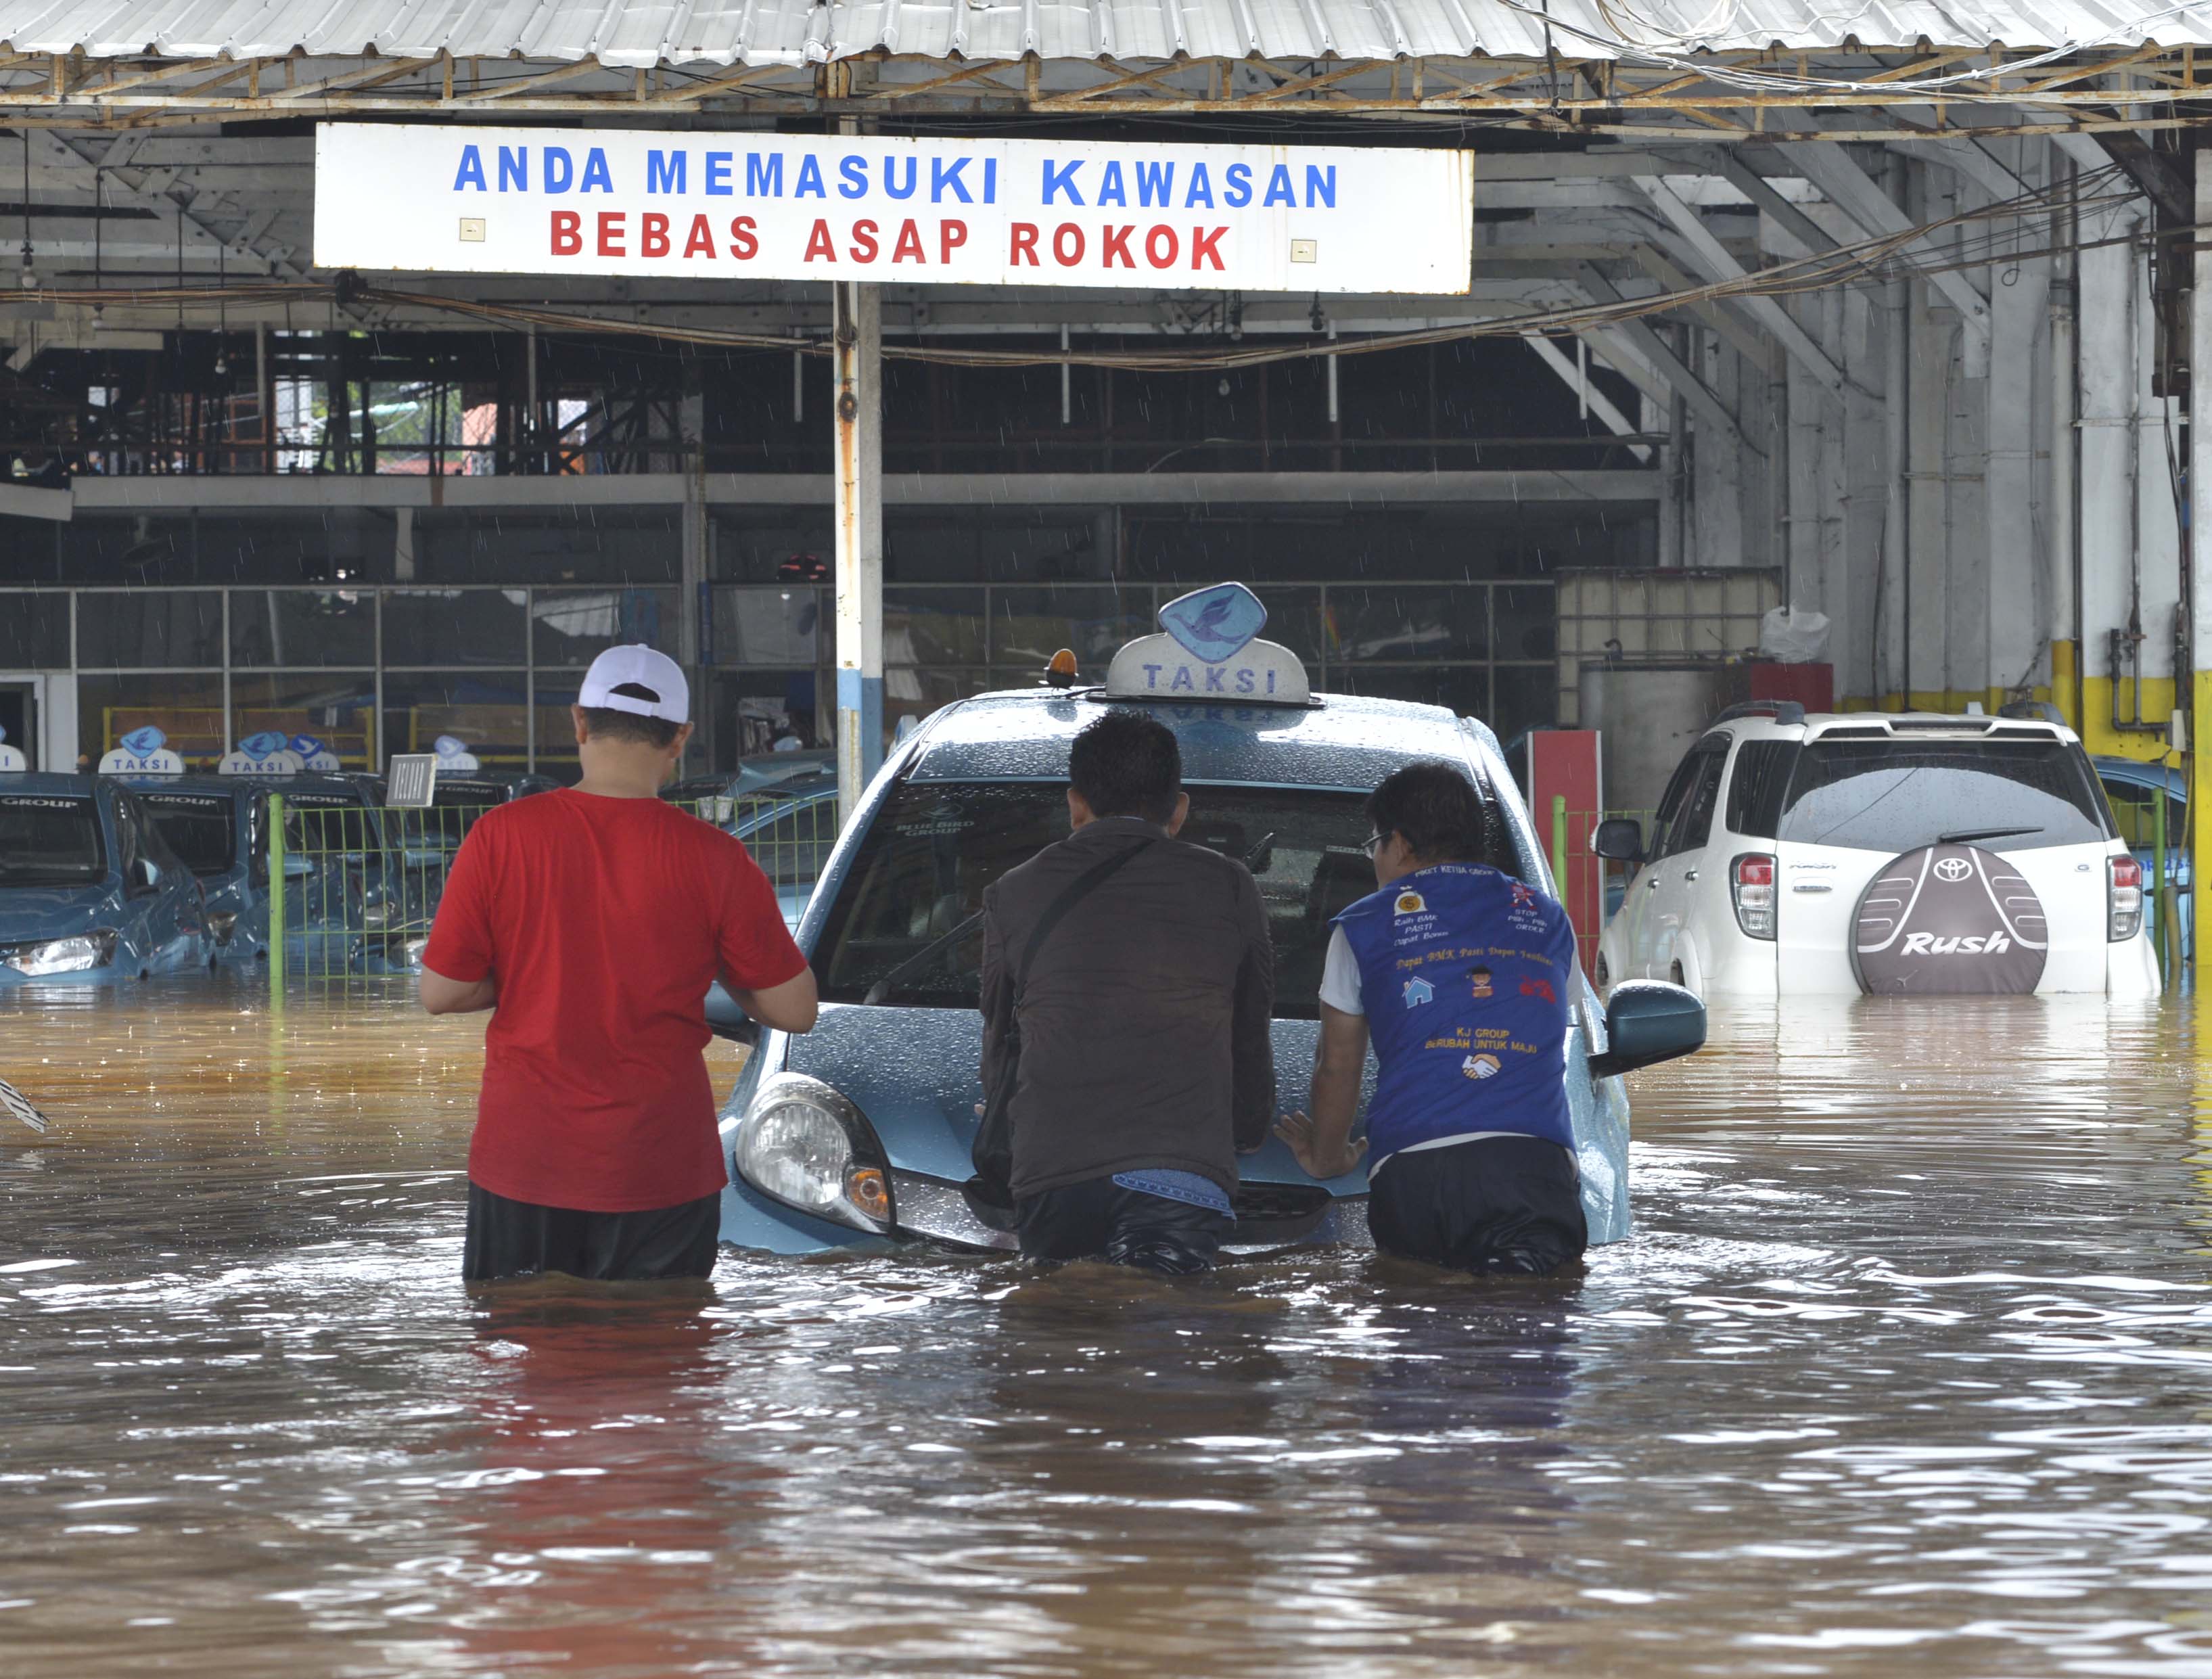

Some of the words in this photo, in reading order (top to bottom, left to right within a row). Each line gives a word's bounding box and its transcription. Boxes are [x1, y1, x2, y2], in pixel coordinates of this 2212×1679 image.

[453, 144, 614, 193] ANDA
[647, 150, 996, 204] MEMASUKI
[1042, 159, 1337, 208] KAWASAN
[551, 210, 759, 260] BEBAS
[804, 218, 968, 263] ASAP
[1010, 222, 1230, 271] ROKOK
[1143, 664, 1275, 693] TAKSI
[114, 759, 168, 769] TAKSI
[232, 762, 283, 772] TAKSI
[306, 761, 329, 769] KSI
[1, 797, 78, 808] GROUP
[148, 795, 216, 805] GROUP
[289, 794, 348, 804] GROUP
[896, 823, 934, 831] BLUE
[904, 827, 961, 836] GROUP
[1515, 908, 1538, 917] STOP
[1404, 923, 1433, 934] PASTI
[1515, 923, 1545, 934] ORDER
[1899, 930, 2011, 956] Rush
[1456, 1027, 1471, 1037] KJ
[1475, 1028, 1511, 1039] GROUP
[1425, 1038, 1470, 1049] BERUBAH
[1473, 1040, 1508, 1051] UNTUK
[1511, 1040, 1538, 1055] MAJU
